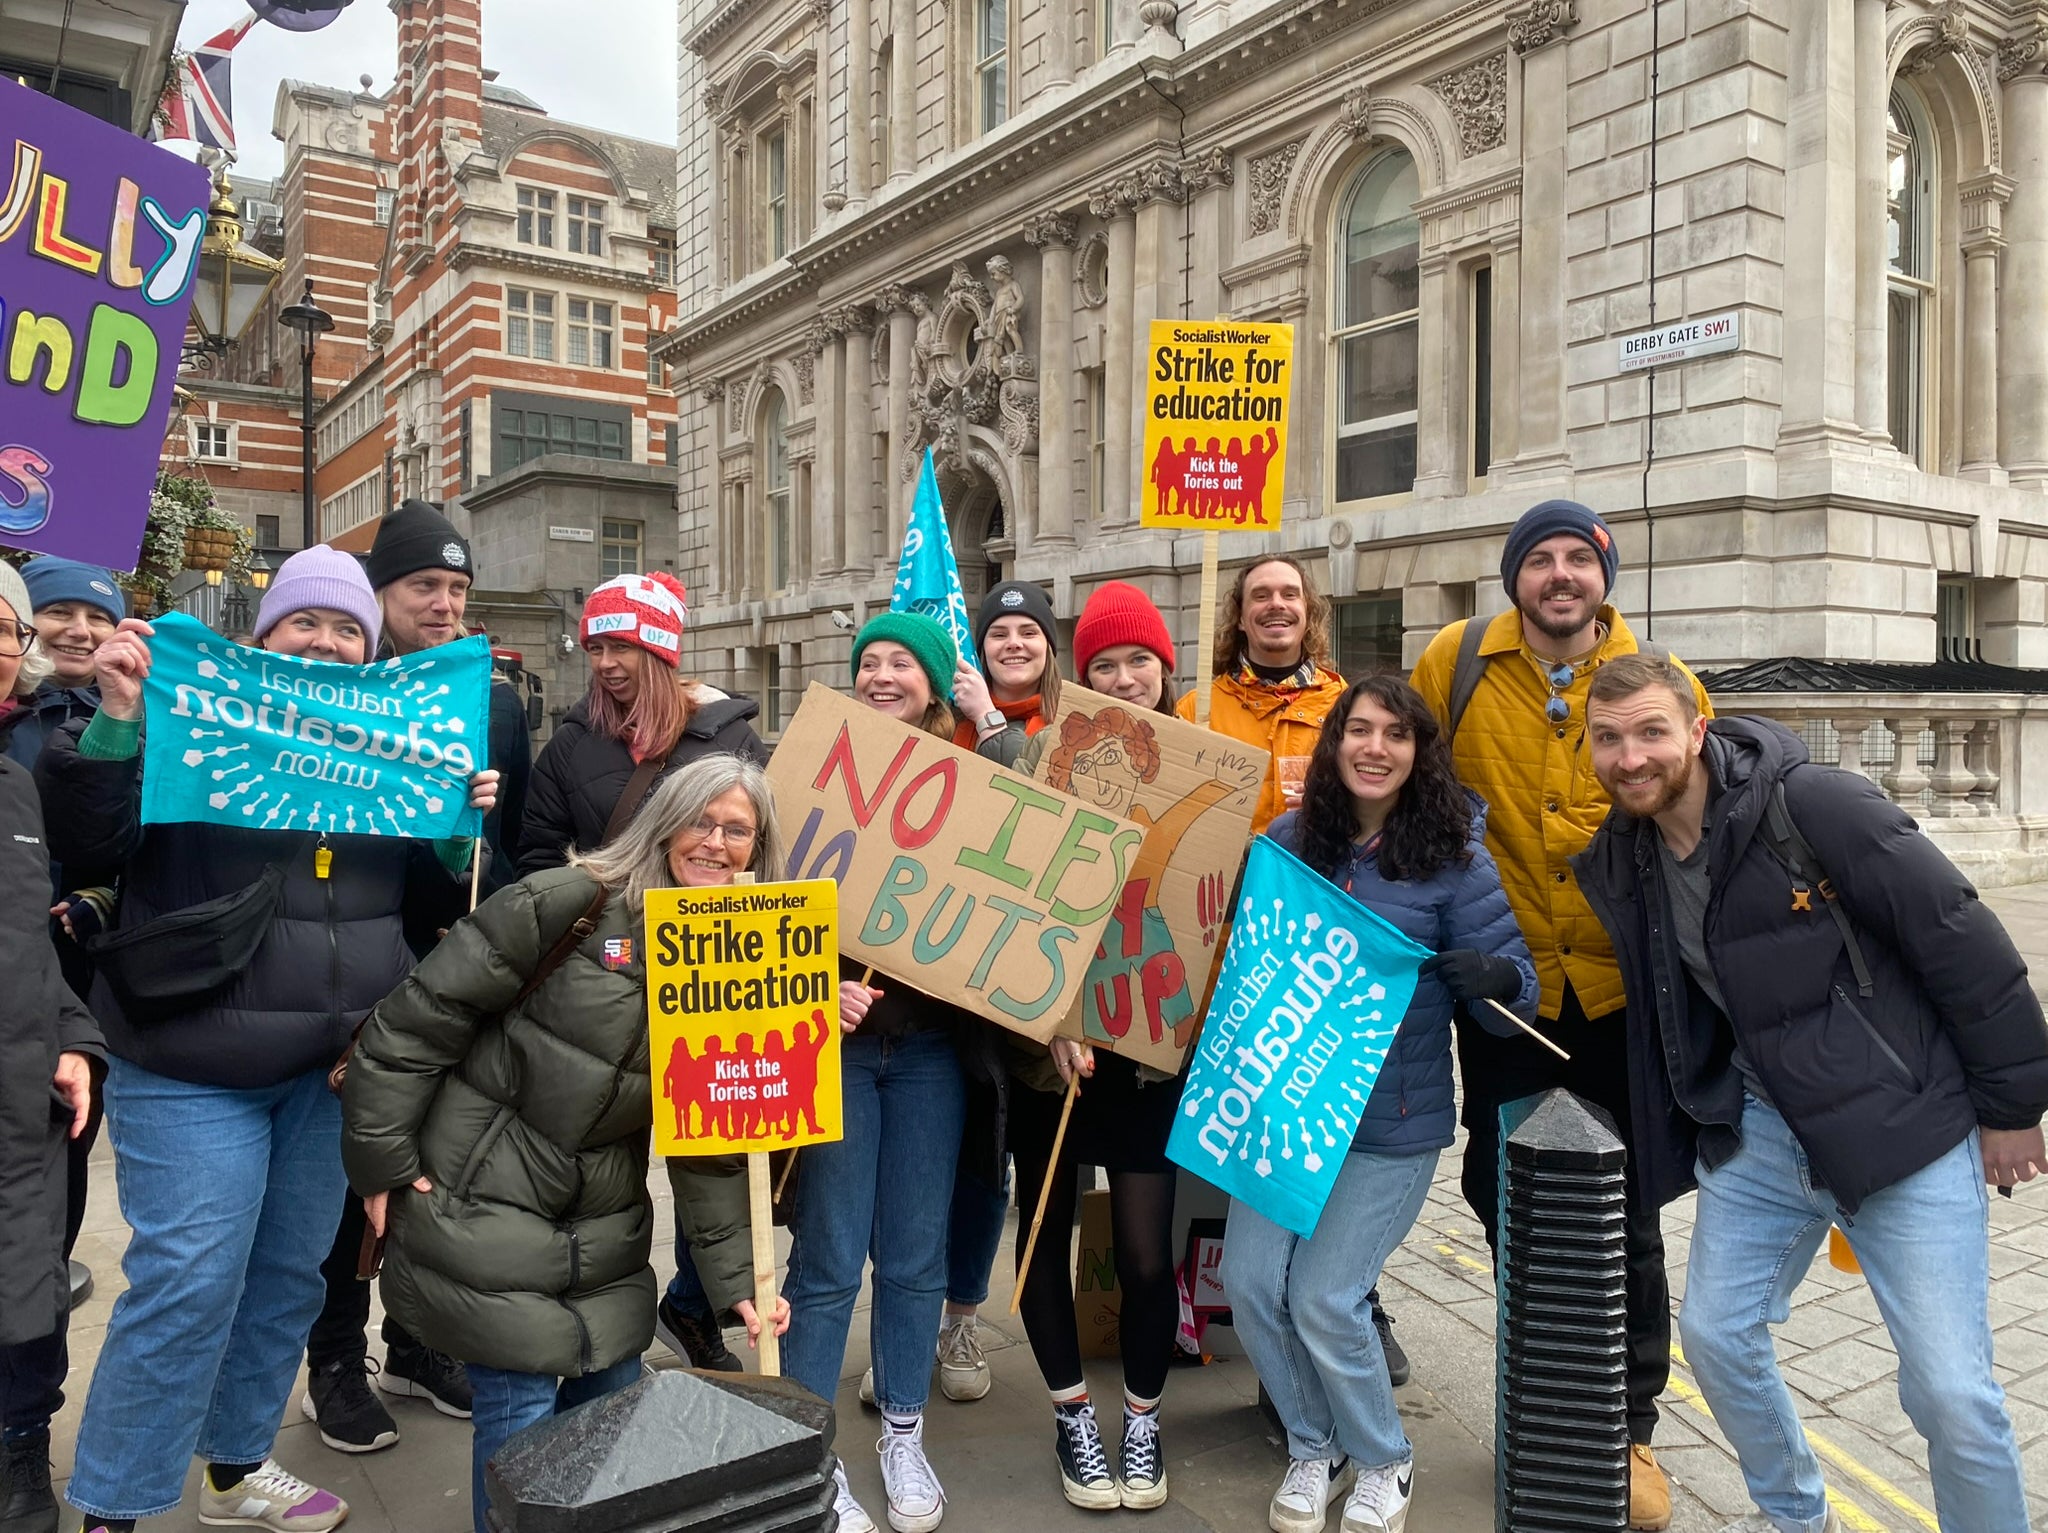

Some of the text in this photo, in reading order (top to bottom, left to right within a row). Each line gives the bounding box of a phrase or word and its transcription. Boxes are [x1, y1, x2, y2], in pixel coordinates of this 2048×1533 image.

[1626, 319, 1730, 354] DERBY GATE SW1
[1155, 346, 1285, 384] Strike for
[1626, 359, 1638, 368] CITY
[1646, 350, 1685, 364] WESTMINSTER
[1153, 385, 1282, 422] education
[1189, 457, 1238, 474] Kick the
[1183, 473, 1243, 490] Tories out
[595, 615, 623, 631] PAY
[646, 628, 671, 647] UP!
[811, 718, 1142, 926] NO IFS
[656, 915, 829, 967] Strike for
[857, 854, 1079, 1022] BUTS
[620, 939, 632, 964] PAY
[658, 963, 830, 1015] education
[1094, 950, 1186, 1045] UP
[715, 1058, 781, 1080] Kick the
[707, 1078, 788, 1102] Tories out
[1200, 1273, 1224, 1292] CHING
